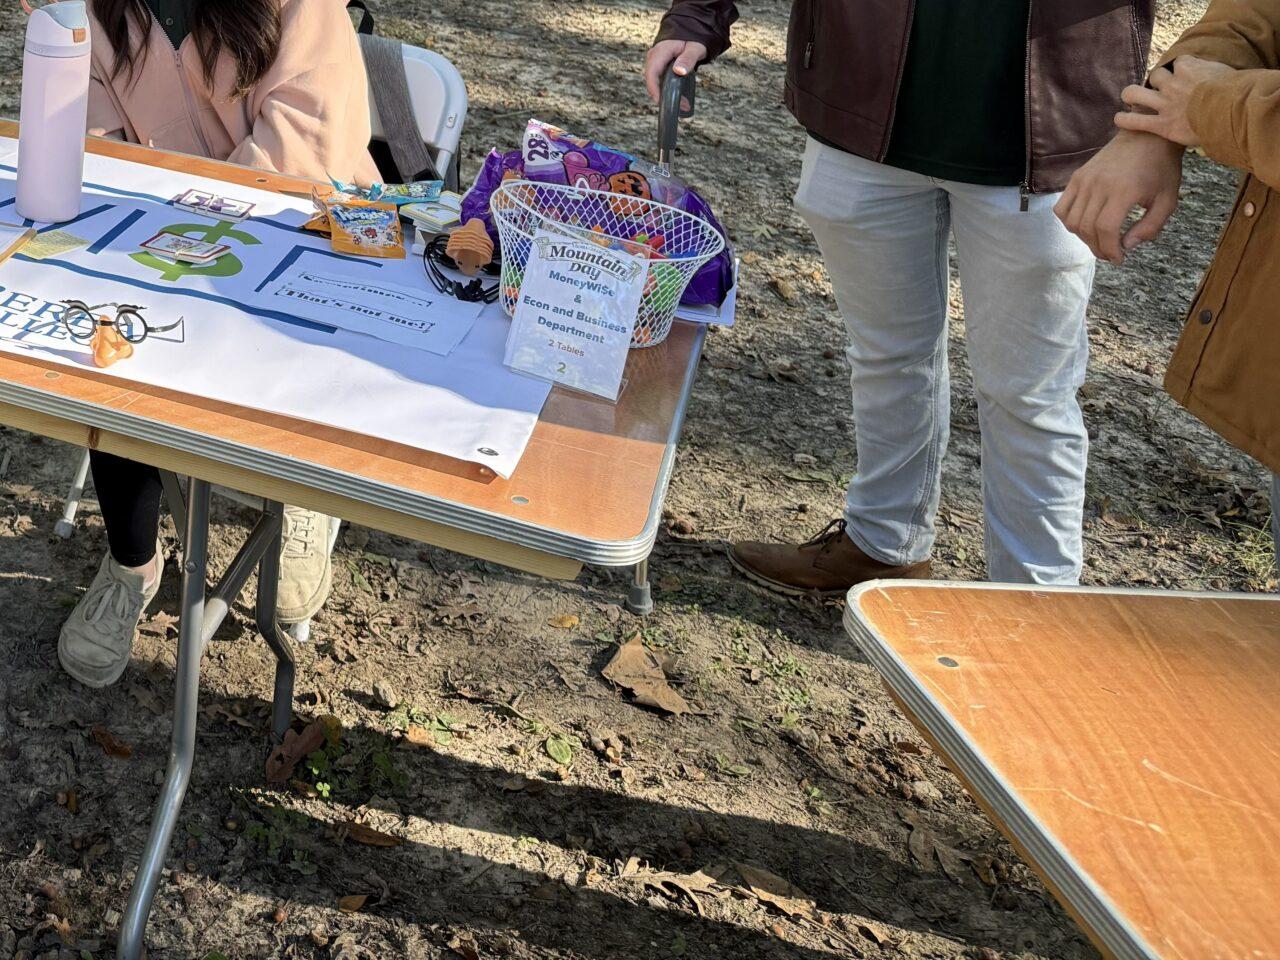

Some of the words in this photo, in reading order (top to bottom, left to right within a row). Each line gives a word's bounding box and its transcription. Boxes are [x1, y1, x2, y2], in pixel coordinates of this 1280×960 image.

[527, 138, 549, 161] 28
[550, 245, 627, 277] Mountain
[568, 262, 602, 281] Day
[549, 270, 616, 297] MoneyWi$e
[573, 294, 582, 304] &
[523, 295, 550, 311] Econ
[552, 304, 574, 318] and
[576, 311, 627, 334] Business
[537, 316, 605, 344] Department
[548, 339, 554, 347] 2
[557, 342, 585, 357] Tables
[556, 361, 567, 374] 2
